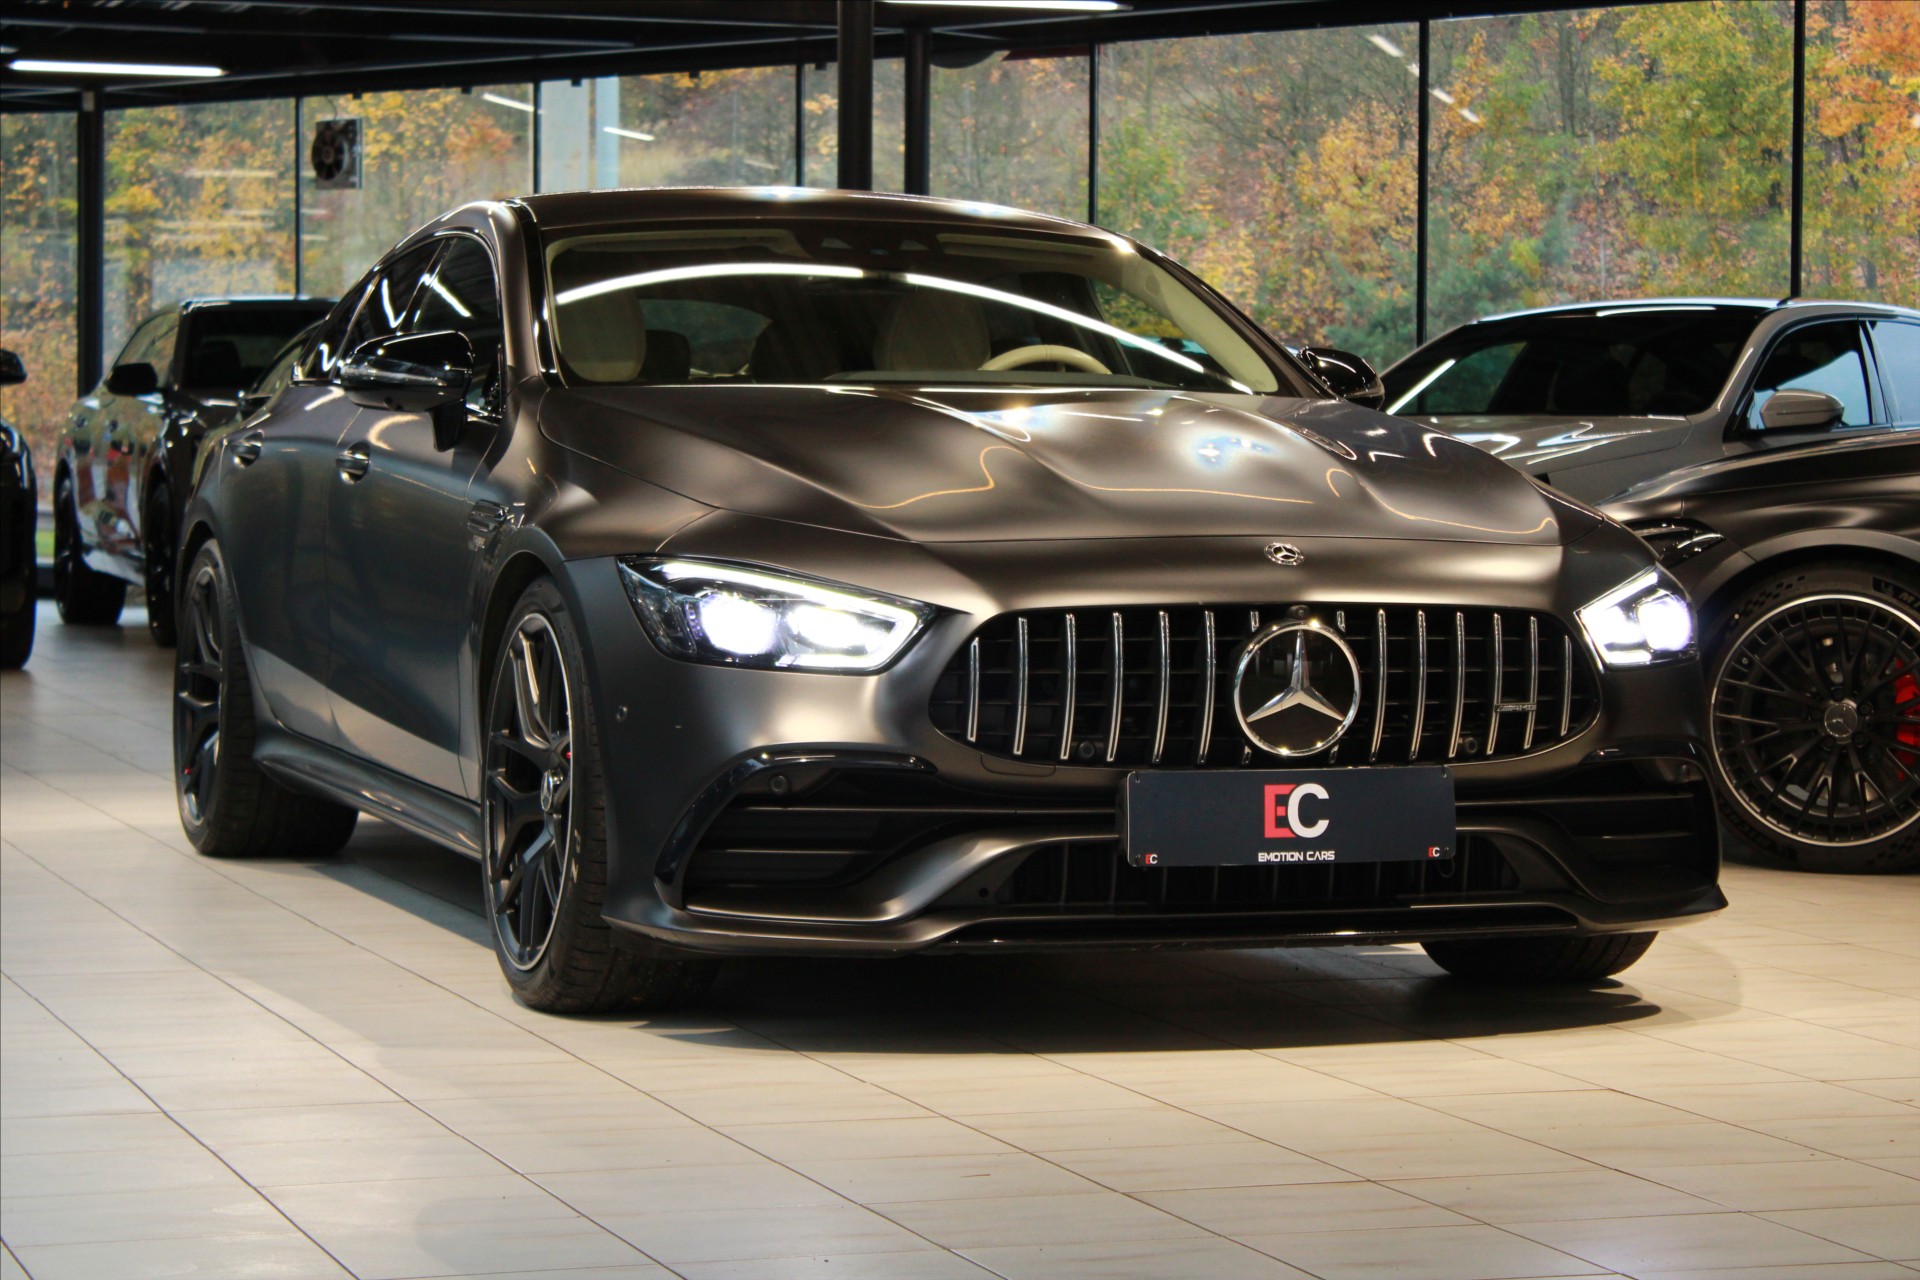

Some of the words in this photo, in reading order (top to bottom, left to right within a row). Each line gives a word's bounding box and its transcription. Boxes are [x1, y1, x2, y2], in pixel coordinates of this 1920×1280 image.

[1264, 783, 1330, 838] EC
[1258, 851, 1304, 862] EMOTION
[1306, 850, 1336, 861] CARS
[1428, 846, 1440, 858] EC
[1145, 853, 1158, 865] EC
